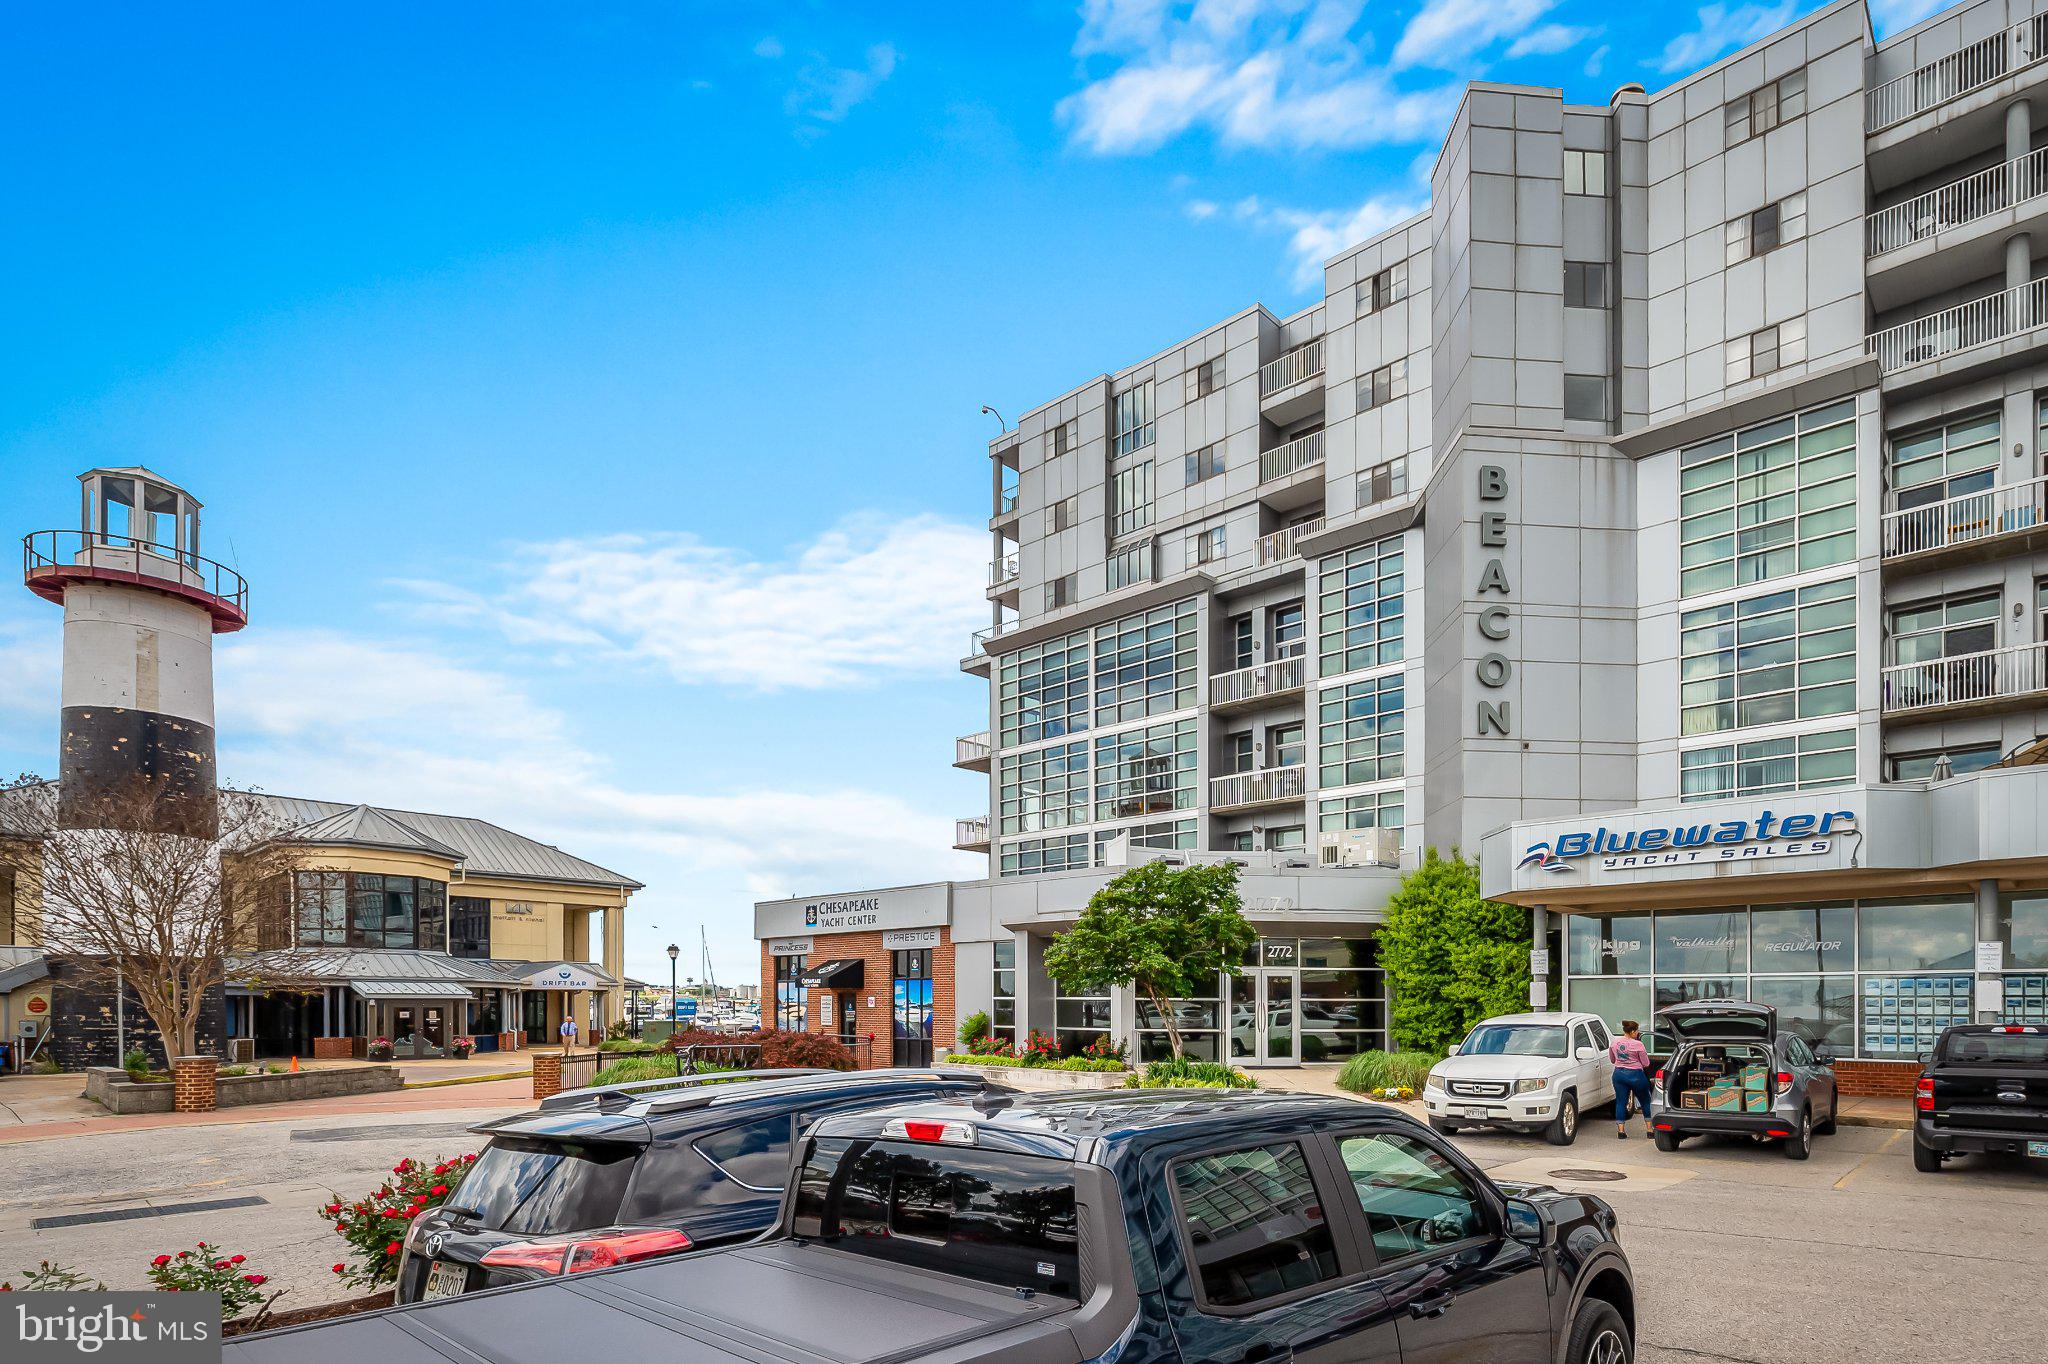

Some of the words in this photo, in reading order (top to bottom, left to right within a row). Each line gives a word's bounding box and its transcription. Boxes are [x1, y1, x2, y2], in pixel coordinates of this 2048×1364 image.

[1477, 464, 1512, 736] BEACON
[1554, 809, 1856, 858] Bluewater
[1604, 850, 1698, 868] YACHT
[1721, 841, 1828, 860] SALES
[819, 898, 879, 916] CHESAPEAKE
[820, 917, 845, 928] YACHT
[847, 914, 877, 926] CENTER
[893, 931, 935, 942] PRESTIGE
[773, 943, 809, 952] PRINCESS
[1267, 945, 1293, 958] 2772
[1764, 940, 1842, 952] REGULATOR
